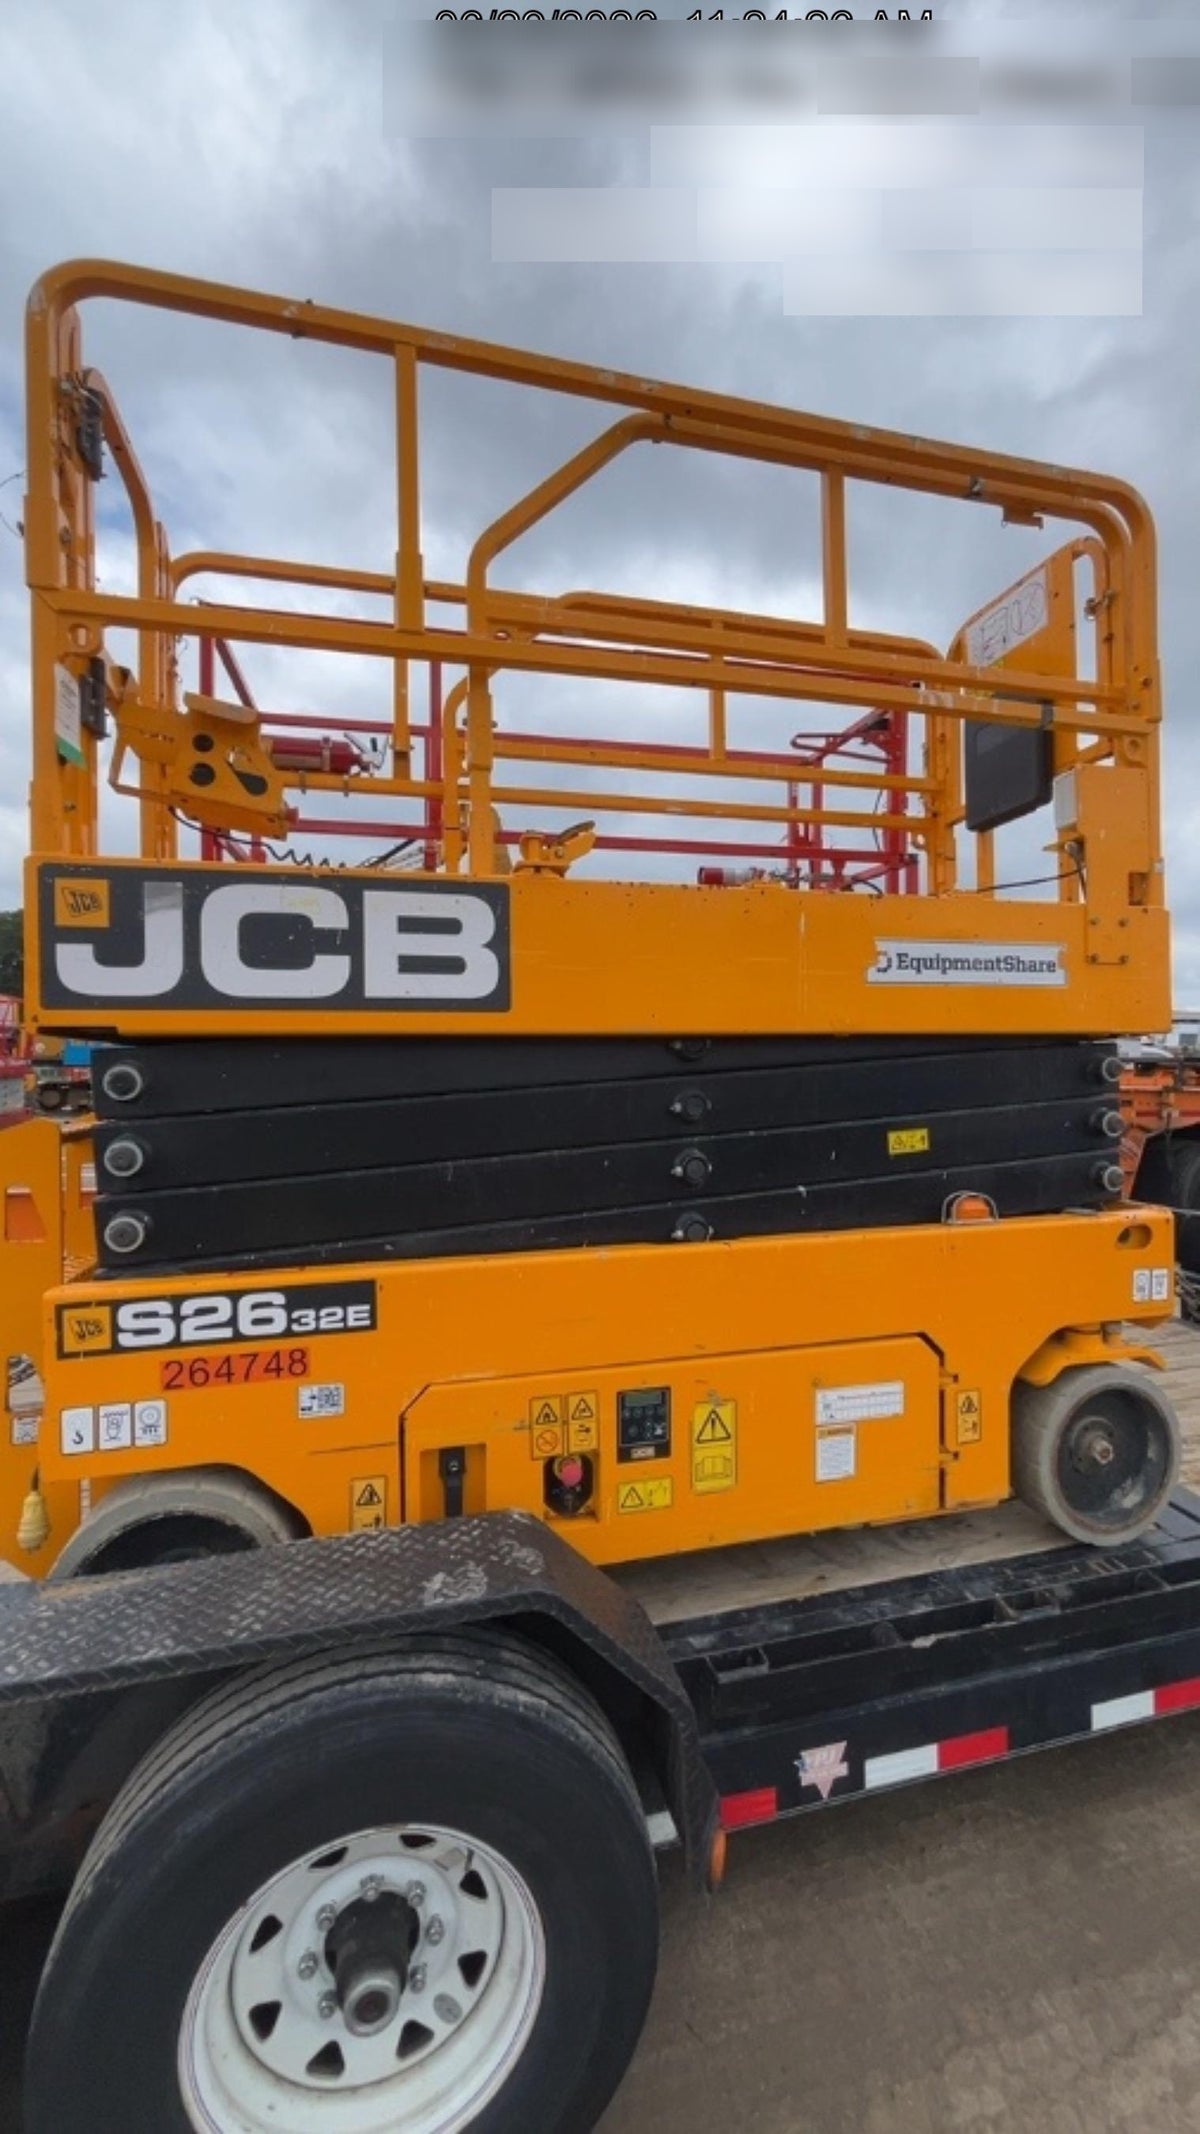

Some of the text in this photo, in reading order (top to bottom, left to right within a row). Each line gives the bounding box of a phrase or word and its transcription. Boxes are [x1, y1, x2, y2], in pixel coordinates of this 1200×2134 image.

[55, 881, 500, 1000] JCB
[896, 952, 1057, 975] EquipmentShare
[163, 1348, 309, 1390] 264748
